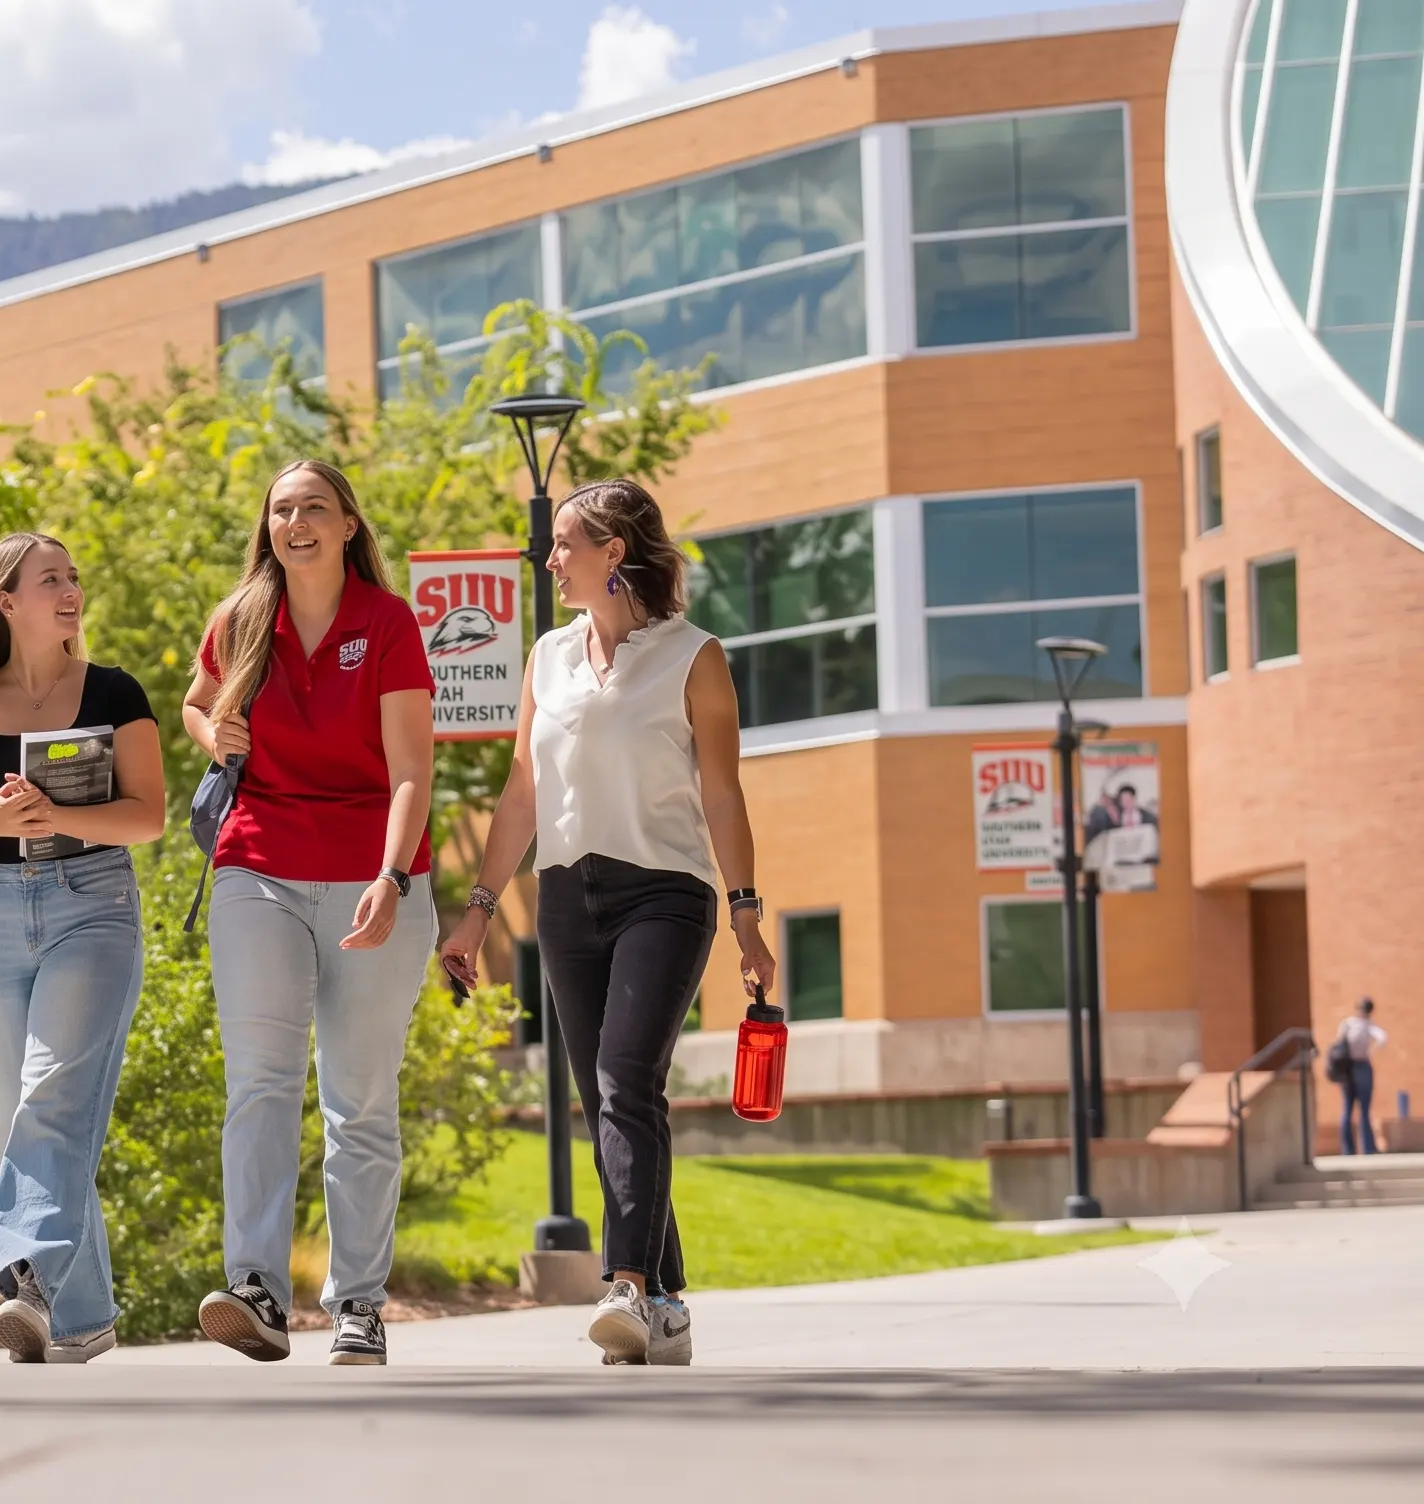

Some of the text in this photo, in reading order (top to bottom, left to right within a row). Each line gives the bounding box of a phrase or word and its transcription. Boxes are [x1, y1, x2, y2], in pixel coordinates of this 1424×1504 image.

[416, 573, 515, 627] SUU
[339, 638, 368, 658] SUU
[429, 664, 507, 681] OUTHERN
[433, 686, 464, 702] AH
[433, 704, 517, 722] IVERSITY
[979, 759, 1045, 795] SUU
